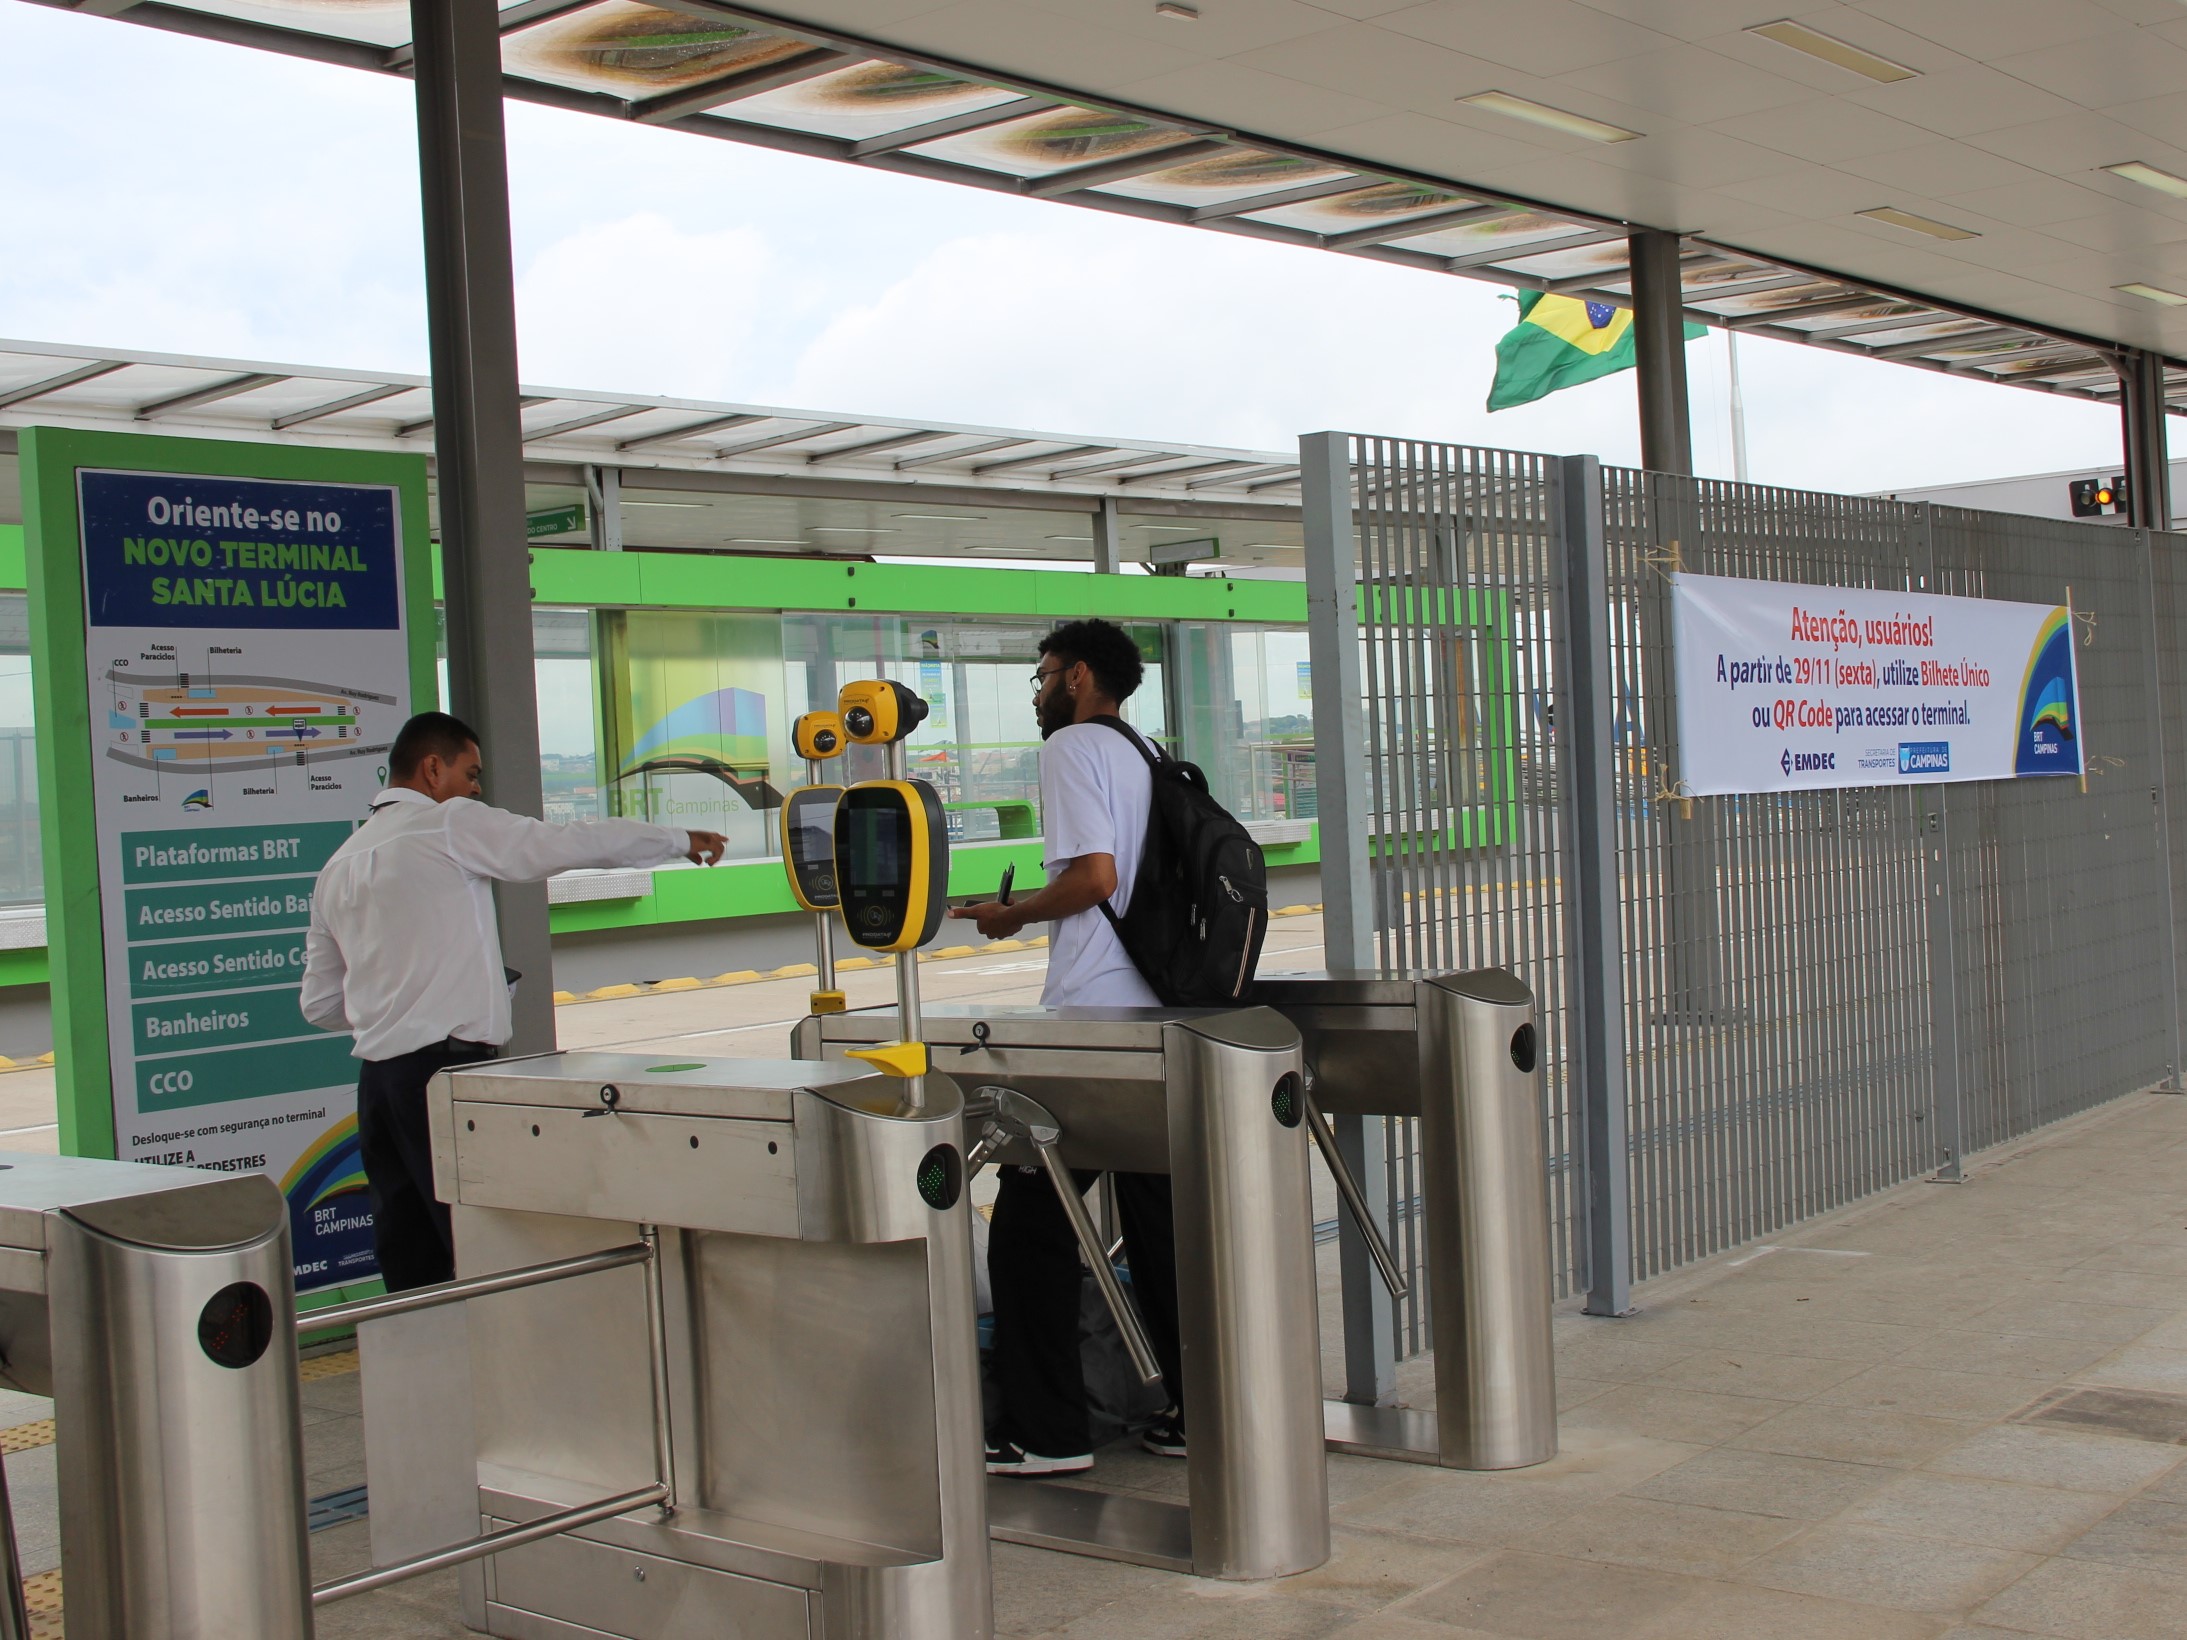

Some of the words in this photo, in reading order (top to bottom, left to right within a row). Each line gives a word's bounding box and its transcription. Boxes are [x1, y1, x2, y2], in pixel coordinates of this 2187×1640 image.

[147, 496, 300, 530] Oriente-se
[307, 509, 341, 532] no
[537, 523, 558, 533] CENTRO
[124, 537, 212, 567] NOVO
[220, 541, 367, 571] TERMINAL
[152, 577, 254, 606] SANTA
[261, 574, 346, 607] LÚCIA
[1791, 607, 1862, 651] Atenção,
[1866, 613, 1933, 647] usuários!
[114, 659, 129, 667] CCO
[141, 653, 175, 661] Paraciclos
[1717, 654, 1726, 683] A
[1730, 655, 1772, 690] partir
[1775, 655, 1792, 684] de
[1793, 658, 1830, 685] 29/11
[1835, 658, 1880, 689] (sexta),
[1883, 659, 1919, 686] utilize
[1921, 660, 1959, 687] Bilhete
[1961, 657, 1990, 687] Único
[1752, 704, 1770, 728] ou
[1773, 699, 1795, 731] QR
[1799, 699, 1832, 728] Code
[1836, 703, 1863, 734] para
[1865, 704, 1909, 726] acessar
[1911, 705, 1919, 726] o
[1922, 699, 1970, 726] terminal.
[2033, 731, 2043, 743] BRT
[1865, 748, 1889, 756] SECRETARIA
[1889, 748, 1896, 756] DE
[1909, 746, 1939, 754] PREFEITURA
[2033, 743, 2058, 755] CAMPINAS
[1795, 752, 1835, 771] EMDEC
[1858, 759, 1896, 769] TRANSPORTES
[1910, 754, 1948, 769] CAMPINAS
[123, 795, 159, 803] Banheiros
[243, 788, 275, 796] Bilheteria
[608, 788, 664, 818] BRT
[666, 797, 739, 816] Campinas
[135, 843, 259, 867] Plataformas
[263, 838, 300, 859] BRT
[139, 906, 206, 925] Acesso
[210, 896, 281, 919] Sentido
[285, 893, 313, 913] Bai
[143, 961, 209, 980] Acesso
[213, 949, 284, 973] Sentido
[288, 947, 309, 965] Ce
[146, 1010, 249, 1038] Banheiros
[149, 1070, 193, 1094] CCO
[132, 1129, 195, 1146] Desloque-se
[197, 1125, 218, 1136] com
[220, 1117, 270, 1134] segurança
[272, 1116, 285, 1125] no
[286, 1107, 326, 1123] terminal
[186, 1150, 195, 1163] A
[314, 1207, 337, 1222] BRT
[315, 1214, 374, 1235] CAMPINAS
[293, 1260, 328, 1276] MDEC
[338, 1254, 375, 1267] TRANSPORTES
